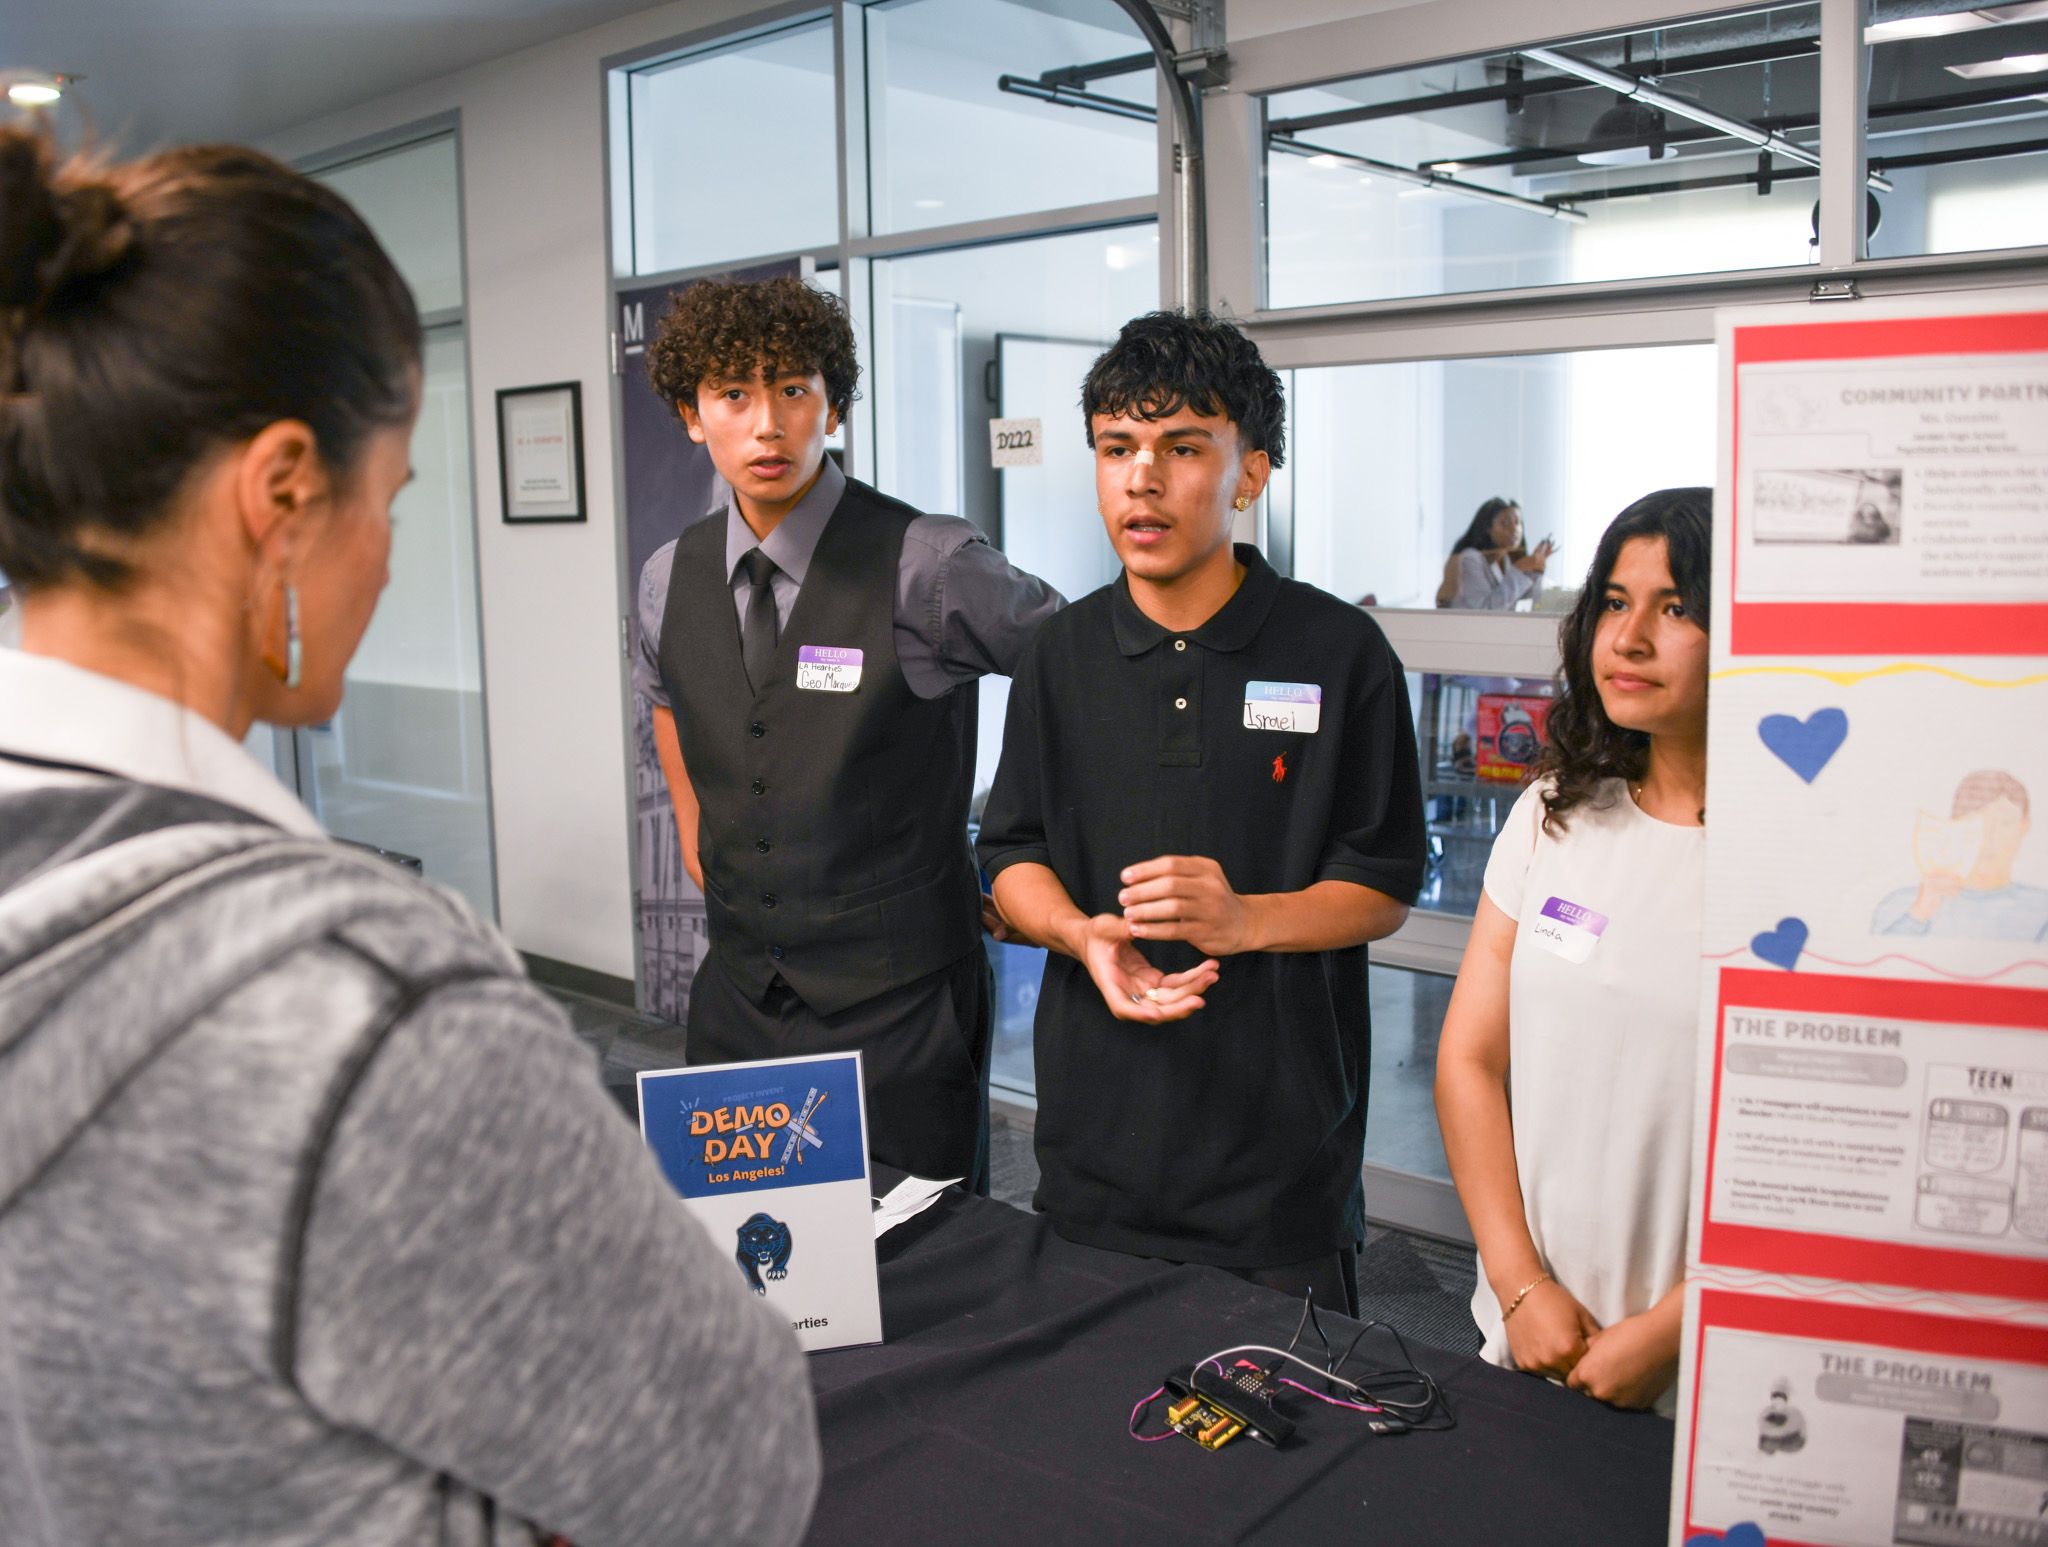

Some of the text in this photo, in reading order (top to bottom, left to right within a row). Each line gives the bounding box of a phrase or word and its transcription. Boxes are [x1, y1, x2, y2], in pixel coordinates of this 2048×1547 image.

[623, 302, 644, 342] M
[1840, 386, 1973, 406] COMMUNITY
[996, 429, 1034, 450] D222
[814, 648, 847, 658] HELLO
[801, 670, 822, 689] Geo
[1264, 685, 1302, 697] HELLO
[1244, 702, 1296, 731] Israel
[1556, 902, 1592, 921] HELLO
[1732, 1016, 1903, 1047] THE PROBLEM
[1967, 1067, 2014, 1090] TEEN
[690, 1102, 792, 1136] DEMO
[703, 1132, 776, 1165] DAY
[708, 1165, 786, 1184] Los Angeles!
[791, 1317, 829, 1331] arties
[1820, 1352, 1865, 1376] THE
[1873, 1358, 1993, 1393] PROBLEM
